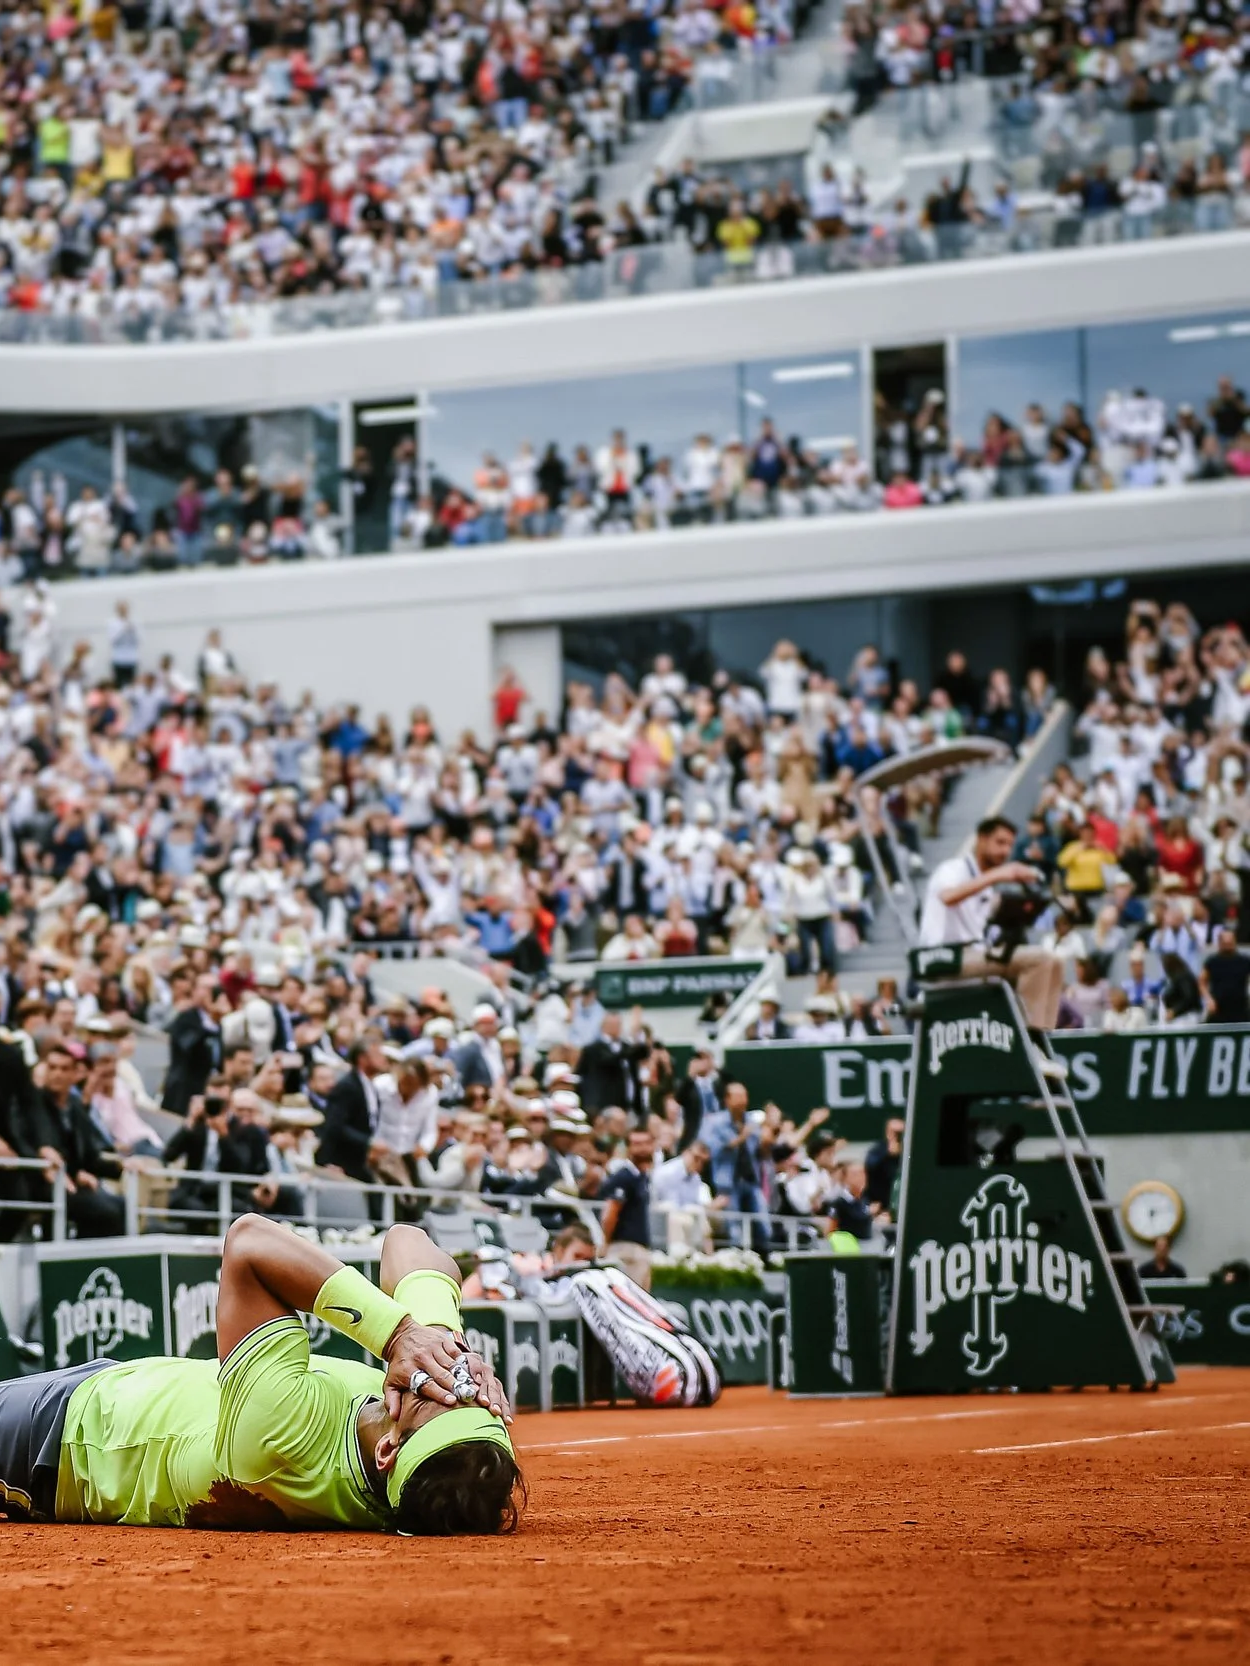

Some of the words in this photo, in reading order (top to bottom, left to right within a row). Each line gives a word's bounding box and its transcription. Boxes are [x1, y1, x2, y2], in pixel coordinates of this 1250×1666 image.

[929, 1011, 1014, 1075] perrier
[1127, 1037, 1198, 1099] FLY
[909, 1221, 1093, 1356] perrier
[53, 1286, 153, 1369] perrier
